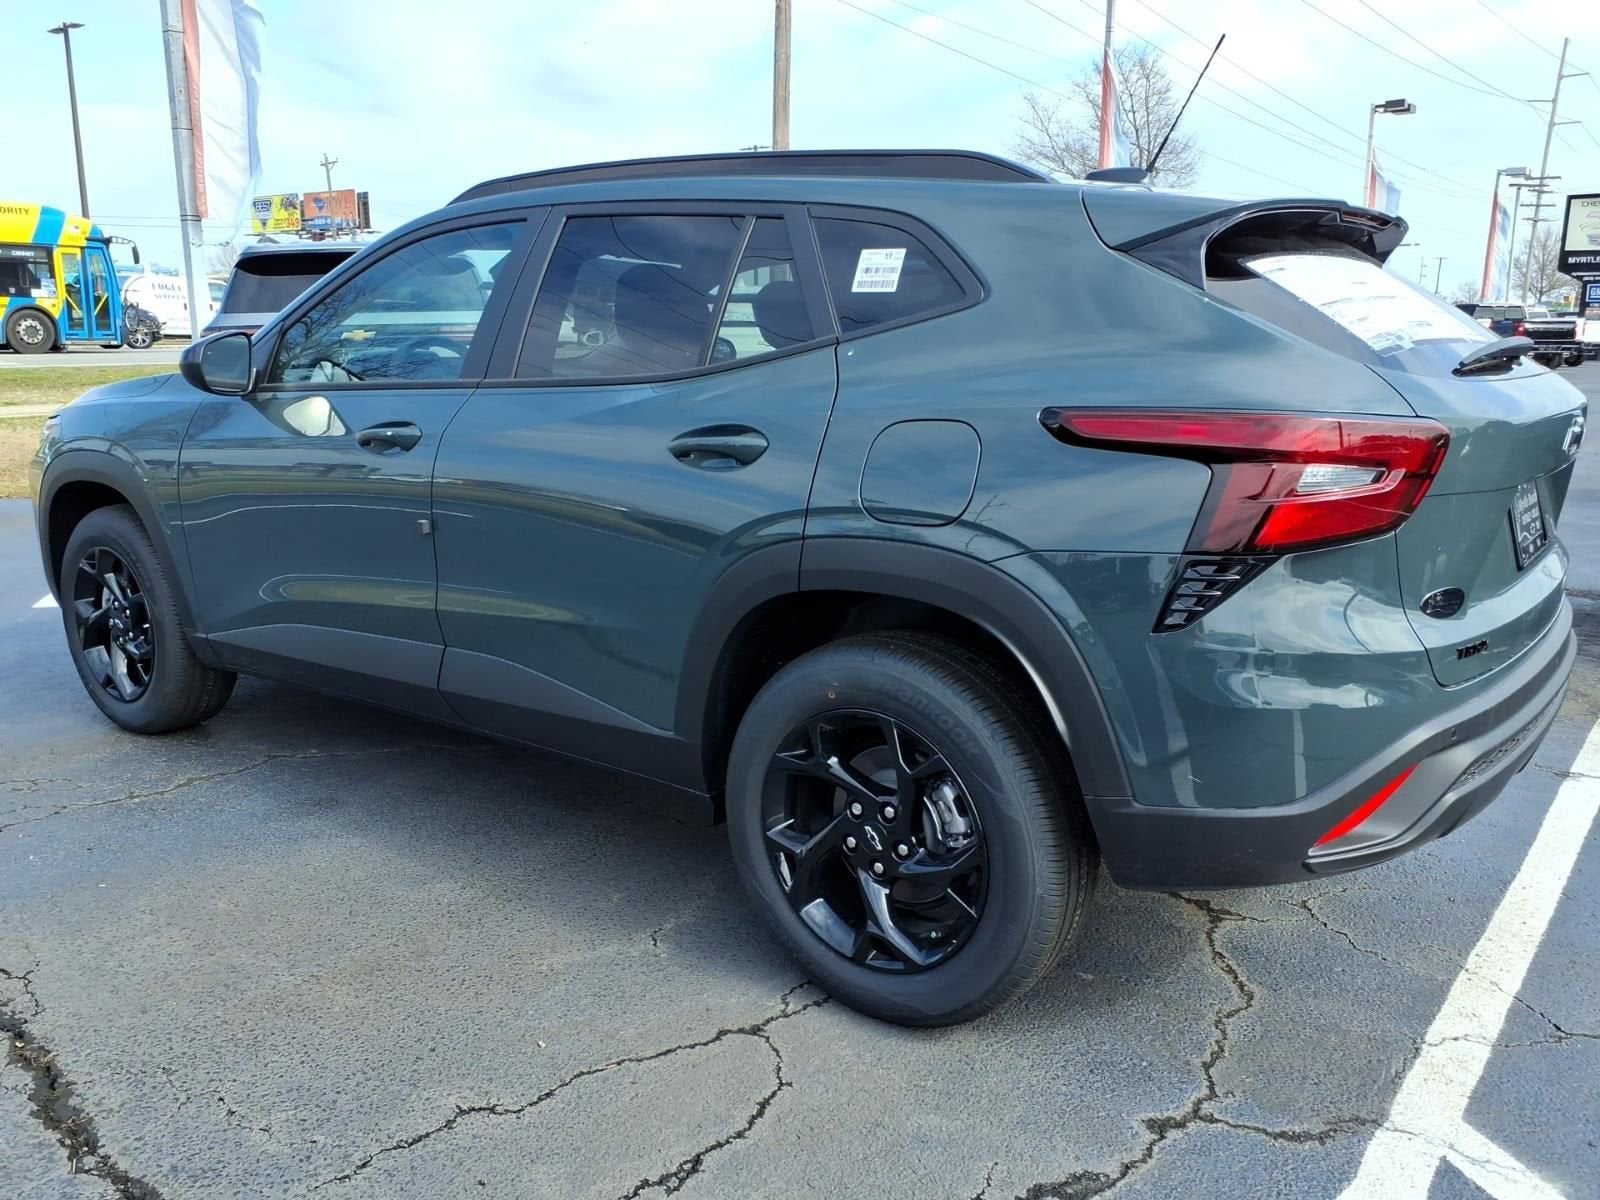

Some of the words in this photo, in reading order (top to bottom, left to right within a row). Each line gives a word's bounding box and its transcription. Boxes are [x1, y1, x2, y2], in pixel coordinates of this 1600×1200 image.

[1581, 200, 1600, 208] CHE
[0, 206, 30, 215] ORITY
[1567, 256, 1600, 264] MYRTLE
